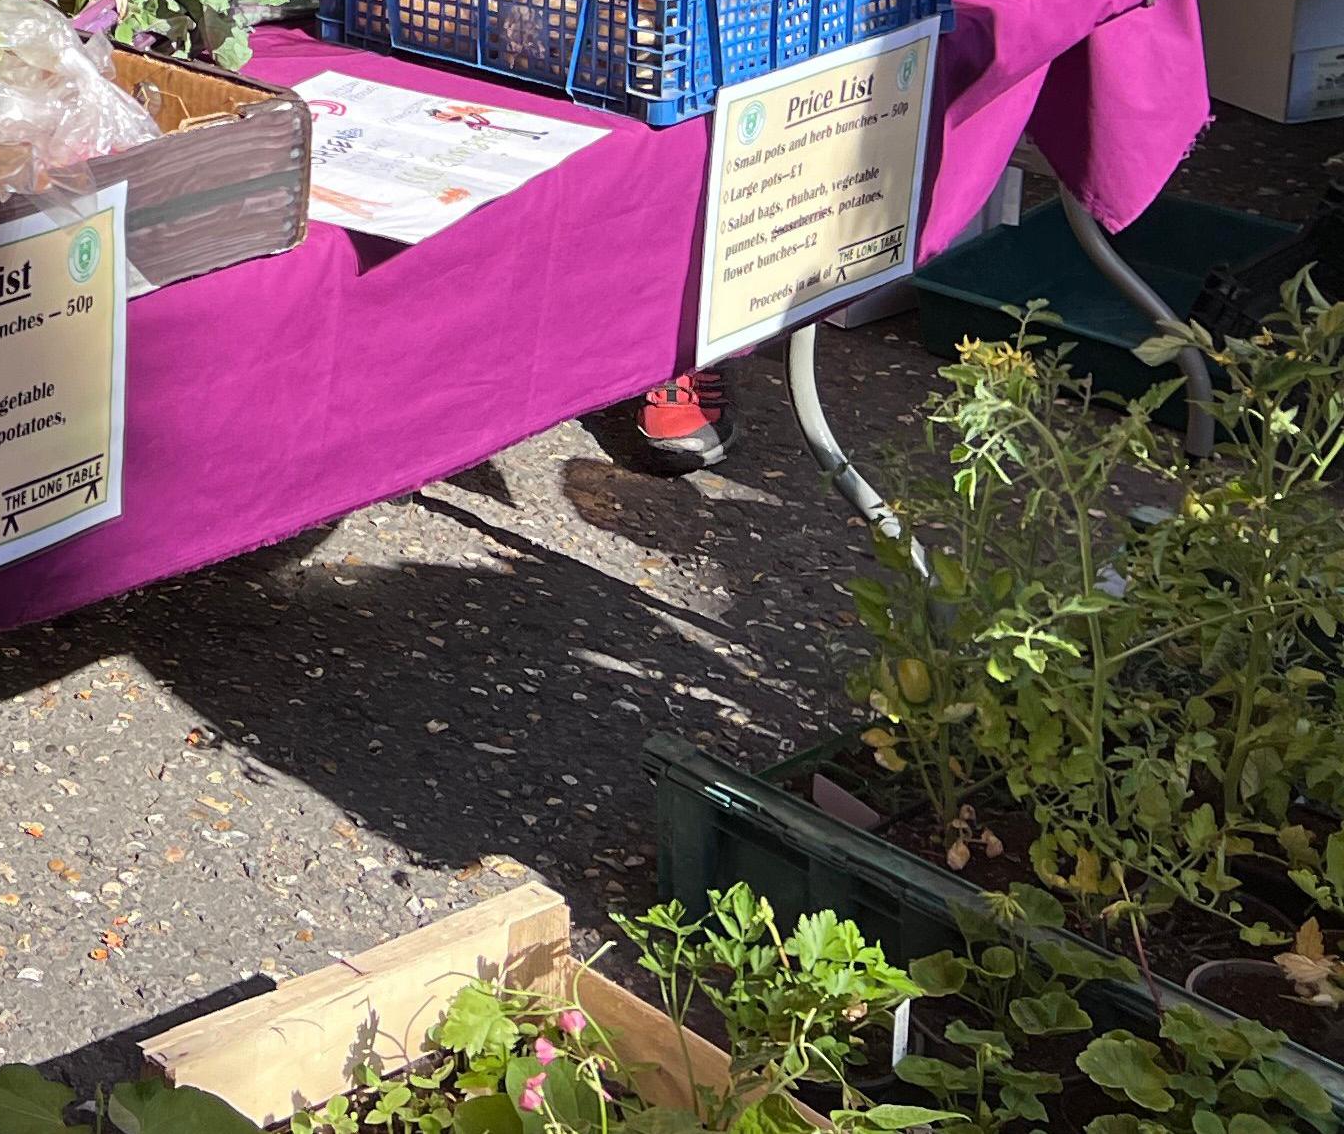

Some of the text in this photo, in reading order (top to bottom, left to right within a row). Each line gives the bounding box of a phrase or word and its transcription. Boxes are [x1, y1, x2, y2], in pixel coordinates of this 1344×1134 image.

[787, 72, 874, 122] Price List
[733, 150, 761, 171] Small
[765, 142, 785, 164] pots
[788, 133, 806, 153] and
[809, 126, 832, 144] herb
[836, 113, 878, 135] bunches
[891, 102, 909, 118] 50p
[727, 166, 880, 233] Salad bags, rhubarb, vegetable
[730, 181, 758, 202] Large
[725, 232, 767, 260] punnets,
[838, 190, 884, 214] potatoes,
[839, 230, 903, 264] THE LONG TABLE
[723, 260, 754, 282] flower
[749, 264, 832, 312] Proceeds in aid of
[66, 294, 93, 320] 50p
[4, 461, 102, 513] THE LONG TABLE
